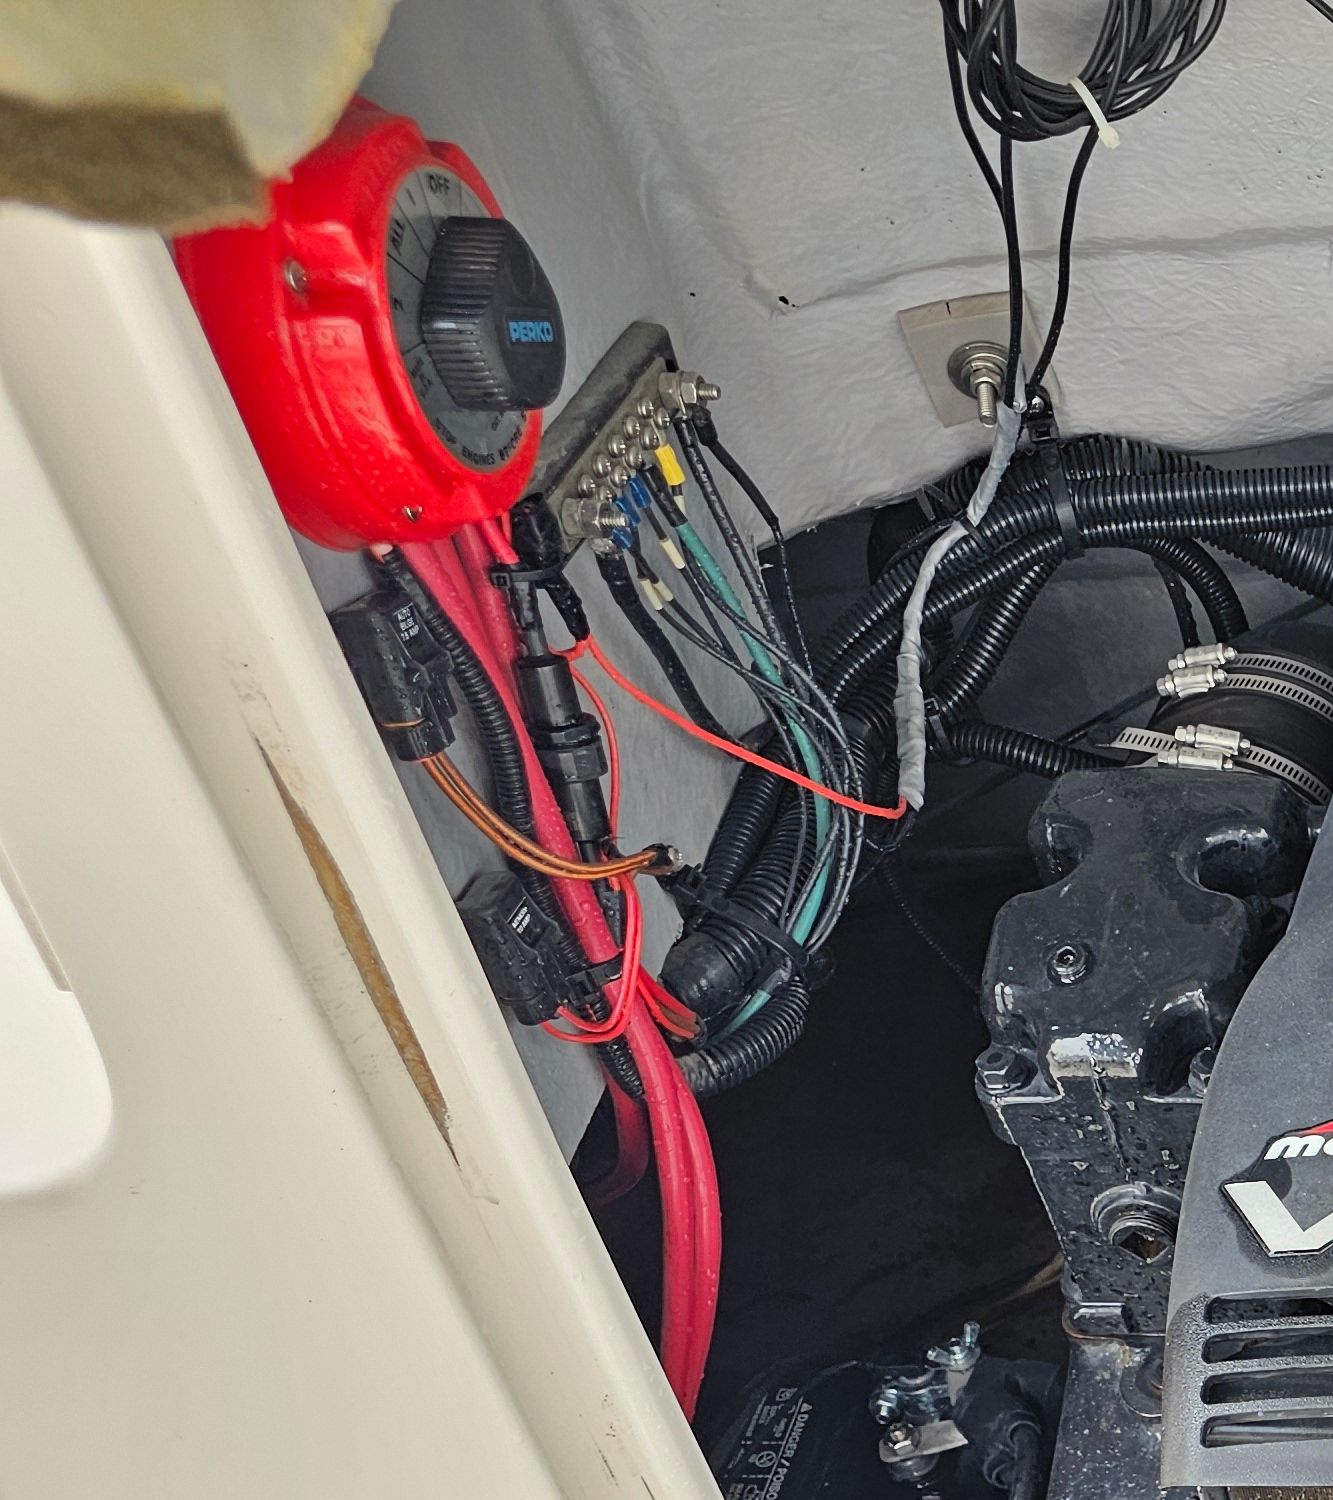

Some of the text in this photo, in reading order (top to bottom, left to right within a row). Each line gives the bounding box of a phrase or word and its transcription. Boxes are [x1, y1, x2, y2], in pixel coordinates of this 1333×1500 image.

[428, 174, 450, 196] OFF
[508, 320, 554, 343] PERKO
[786, 1413, 809, 1458] DANGER
